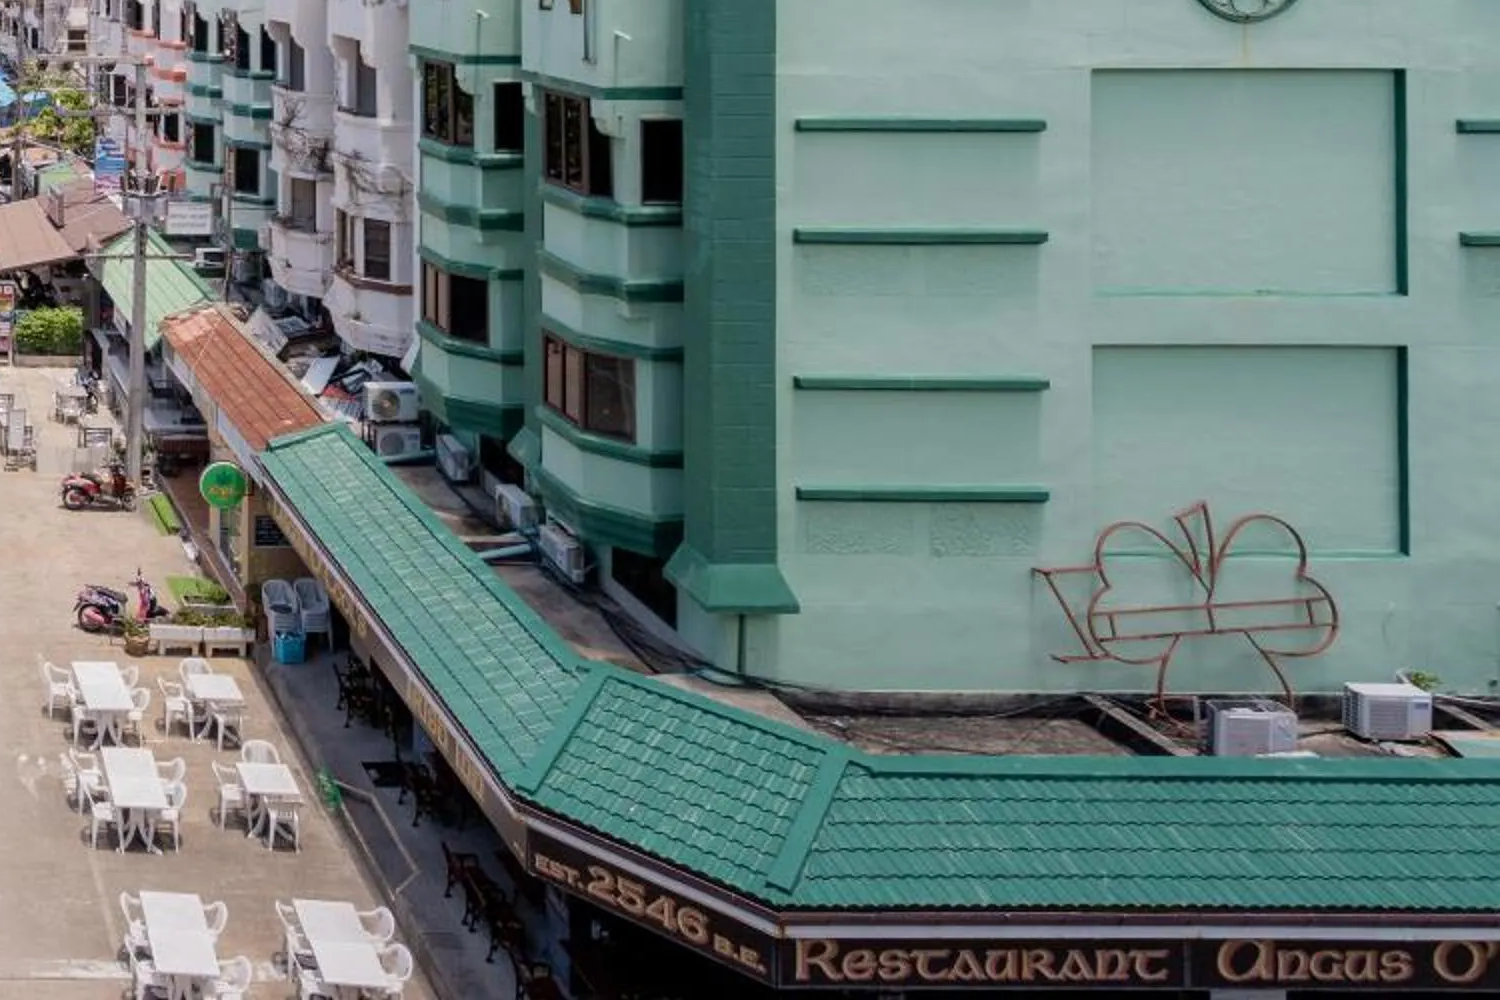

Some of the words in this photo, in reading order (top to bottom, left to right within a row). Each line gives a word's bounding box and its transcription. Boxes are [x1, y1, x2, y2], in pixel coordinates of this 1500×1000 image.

[534, 853, 584, 889] EST.
[587, 865, 709, 945] 2546
[713, 934, 767, 974] B.E.
